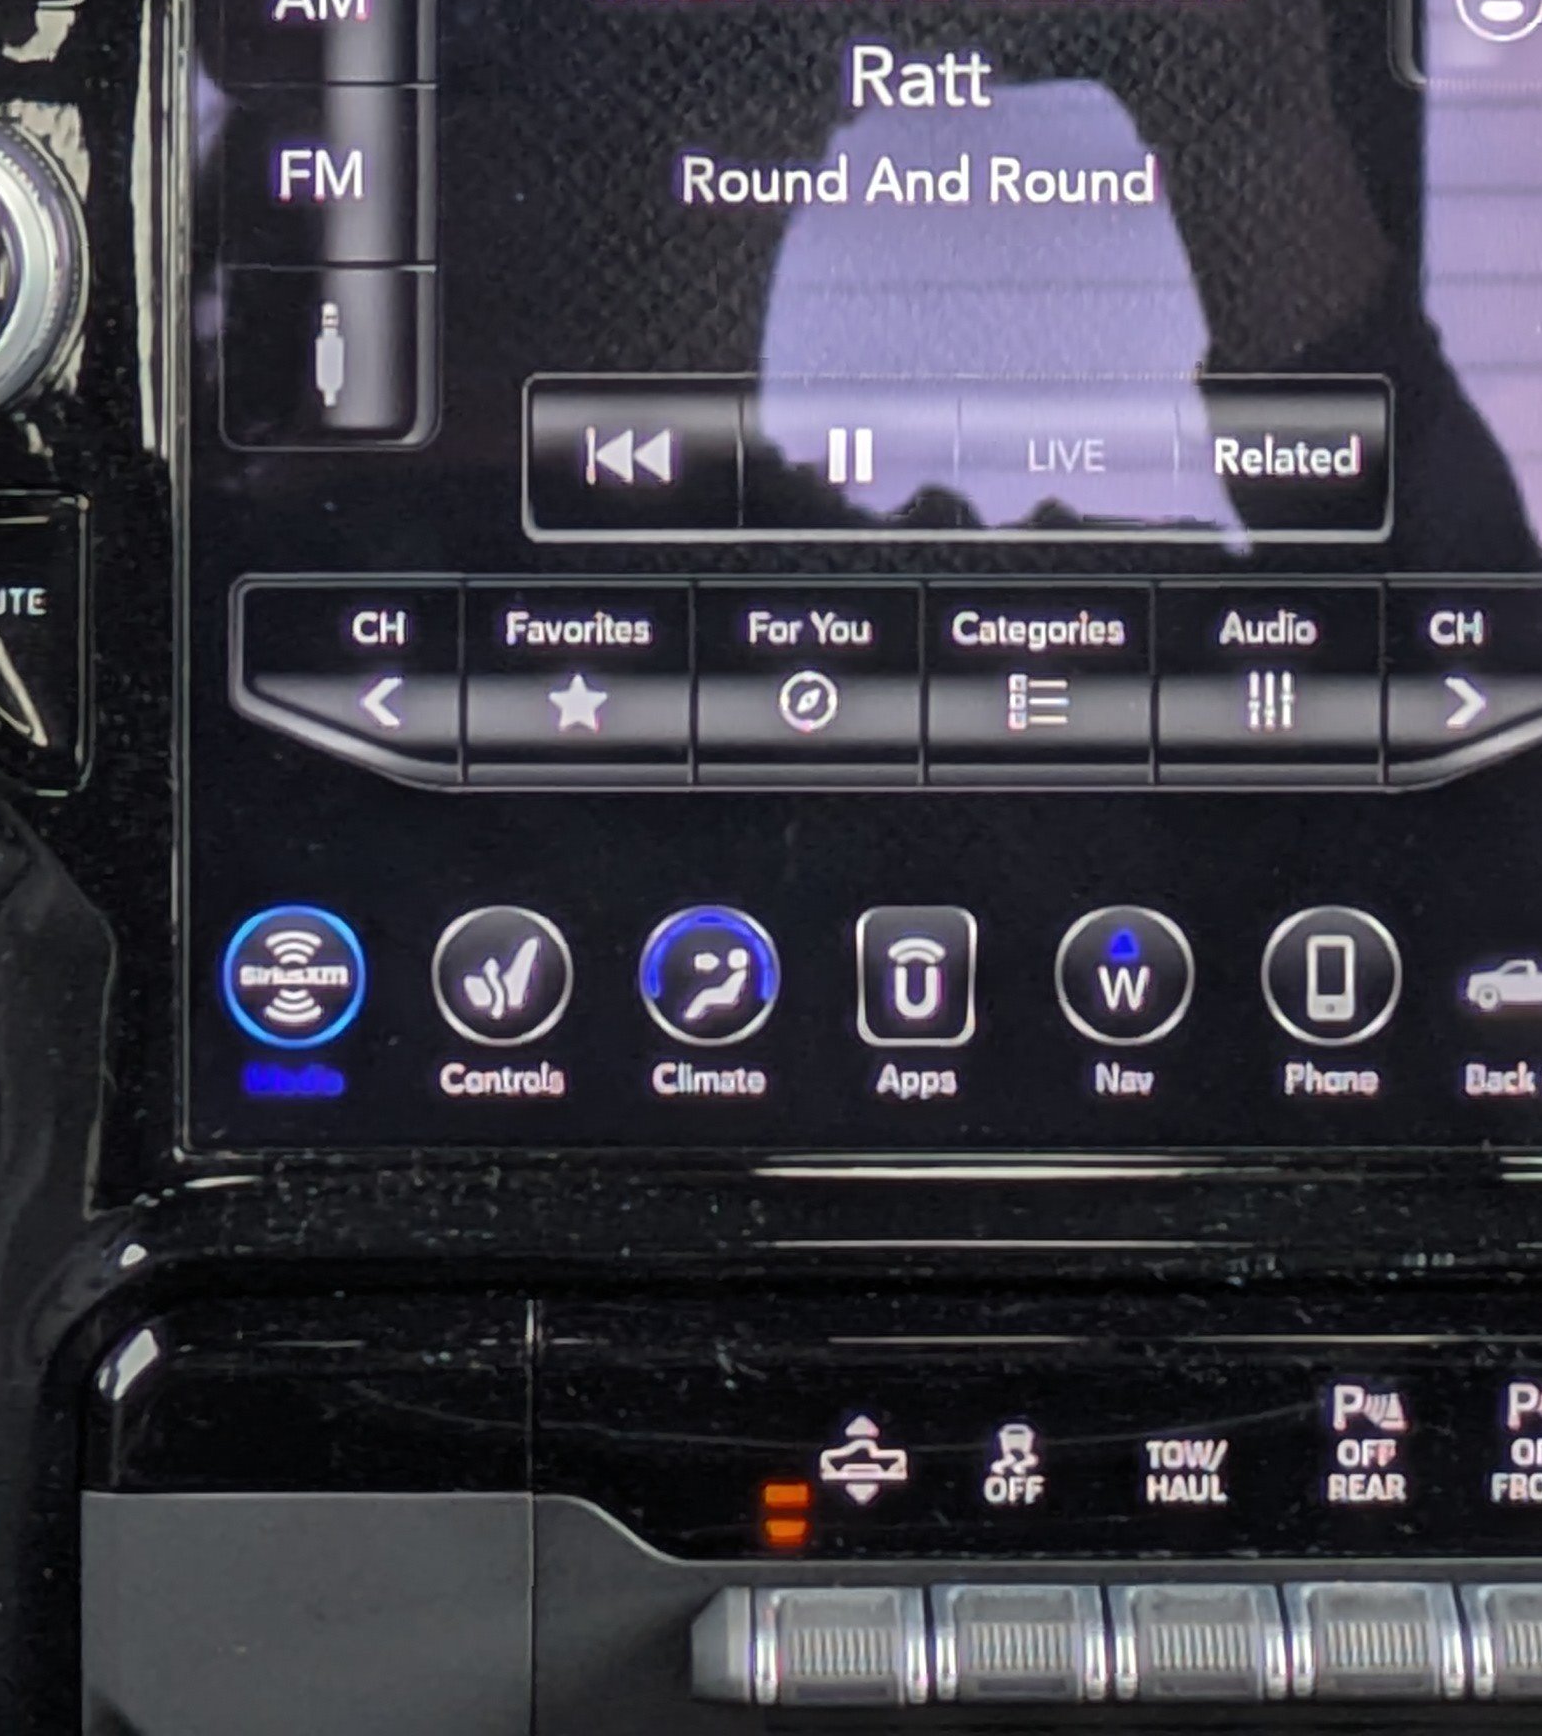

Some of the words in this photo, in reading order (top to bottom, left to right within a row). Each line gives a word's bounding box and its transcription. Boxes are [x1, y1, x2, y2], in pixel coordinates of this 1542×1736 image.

[850, 45, 991, 107] Ratt
[279, 149, 363, 200] FM
[682, 155, 848, 203] Round
[865, 155, 970, 203] And
[990, 155, 1157, 203] Round
[1028, 439, 1107, 473] LIVE
[1215, 435, 1361, 477] Related
[353, 611, 406, 645] CH
[506, 611, 651, 645] Favorites
[749, 611, 803, 645] For
[810, 611, 872, 645] You
[952, 611, 1125, 650] Categories
[1219, 611, 1317, 645] Audio
[1429, 611, 1485, 645] CH
[1097, 965, 1150, 1011] W
[441, 1063, 565, 1096] Controls
[653, 1063, 767, 1096] Climate
[876, 1063, 957, 1100] Apps
[1095, 1063, 1154, 1095] Nav
[1285, 1063, 1379, 1095] Phone
[1465, 1063, 1536, 1095] Back
[1147, 1440, 1227, 1472] TOW/
[1338, 1439, 1397, 1468] OFF
[984, 1476, 1046, 1505] OFF
[1147, 1474, 1227, 1504] HAUL
[1328, 1474, 1406, 1502] REAR
